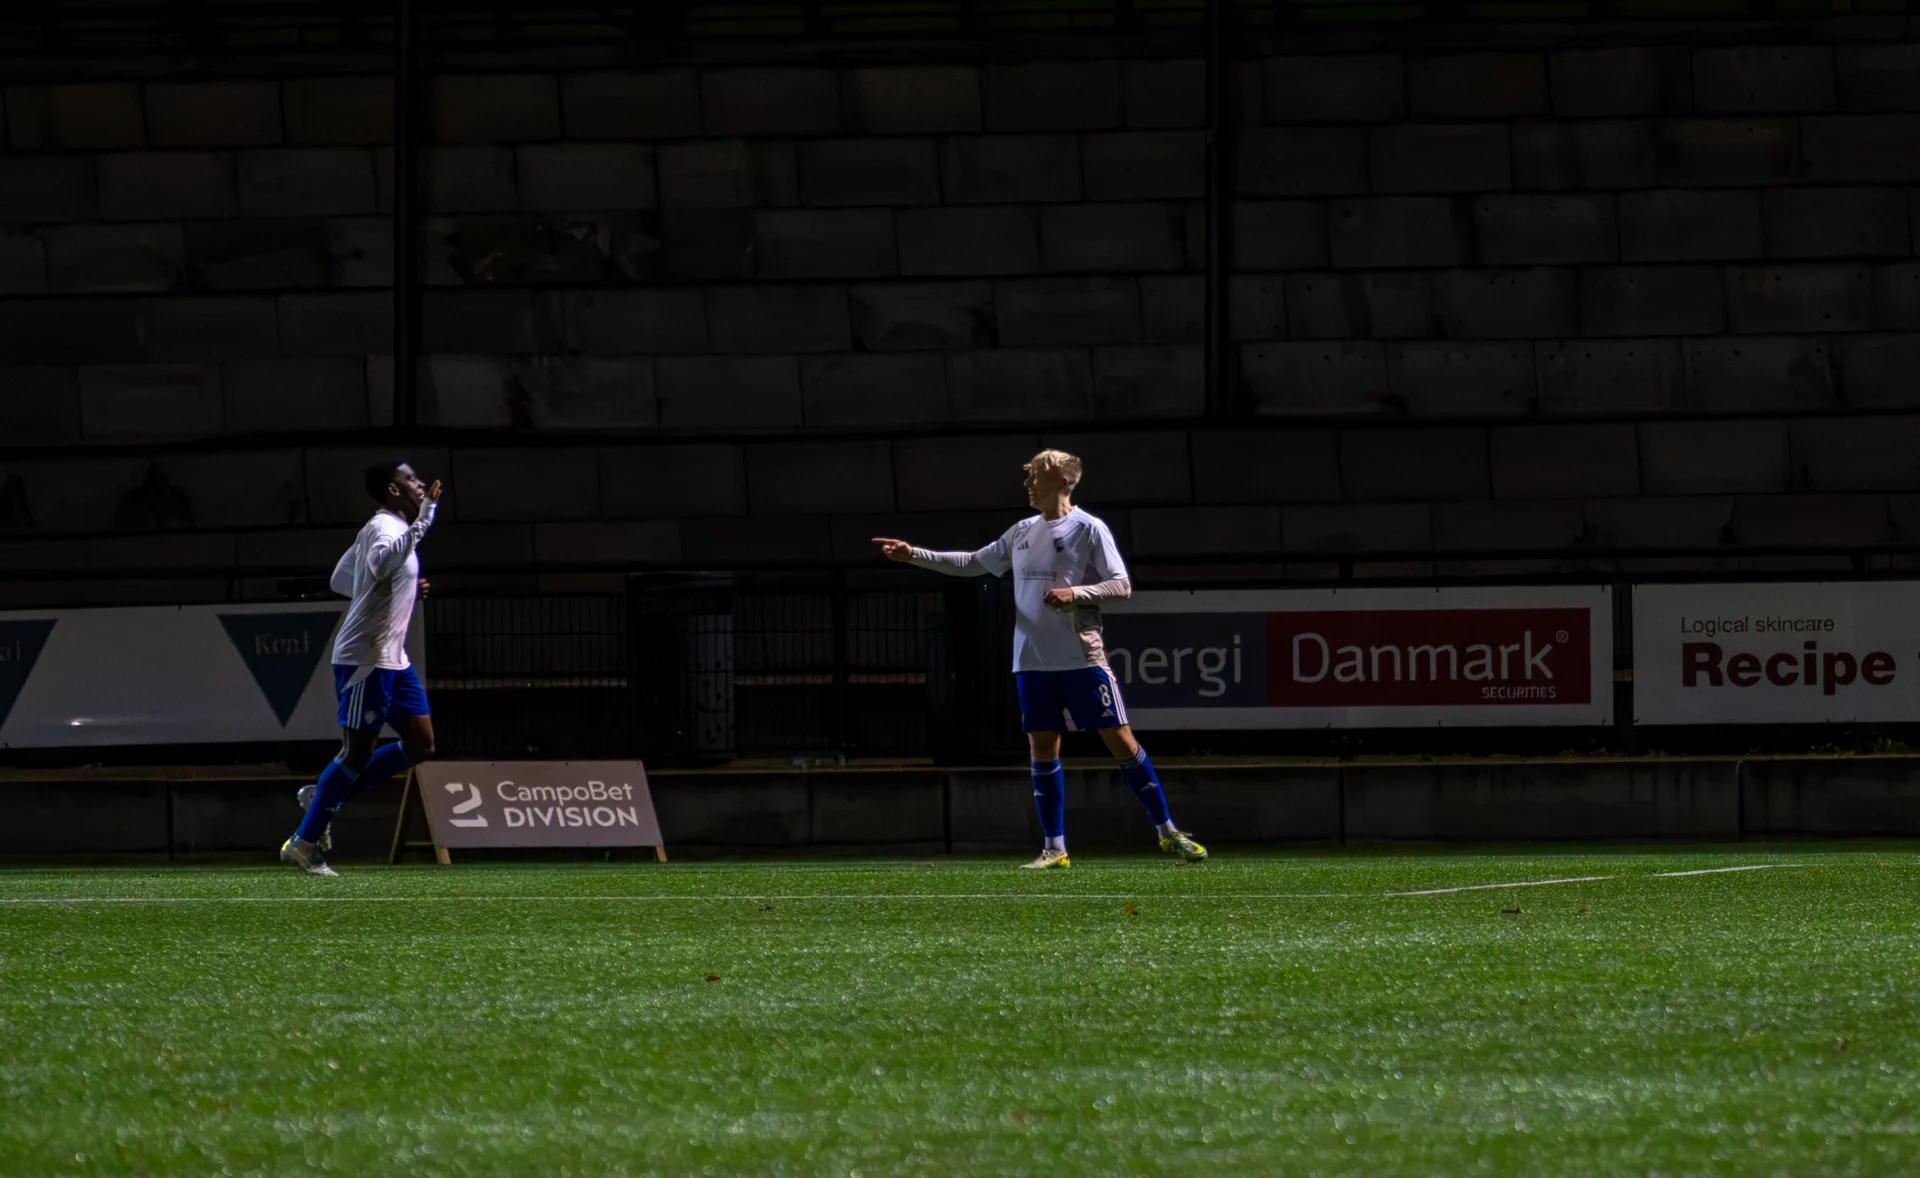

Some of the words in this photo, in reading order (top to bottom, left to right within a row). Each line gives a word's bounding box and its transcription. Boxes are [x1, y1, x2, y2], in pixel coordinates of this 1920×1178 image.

[1681, 616, 1749, 638] Logical
[1755, 615, 1834, 633] skincare
[1107, 634, 1244, 699] nergi
[1682, 640, 1896, 696] Recipe
[1097, 683, 1112, 708] 8
[1481, 685, 1557, 700] SECURITIES
[496, 780, 634, 807] CampoBet
[503, 806, 640, 828] DIVISION
